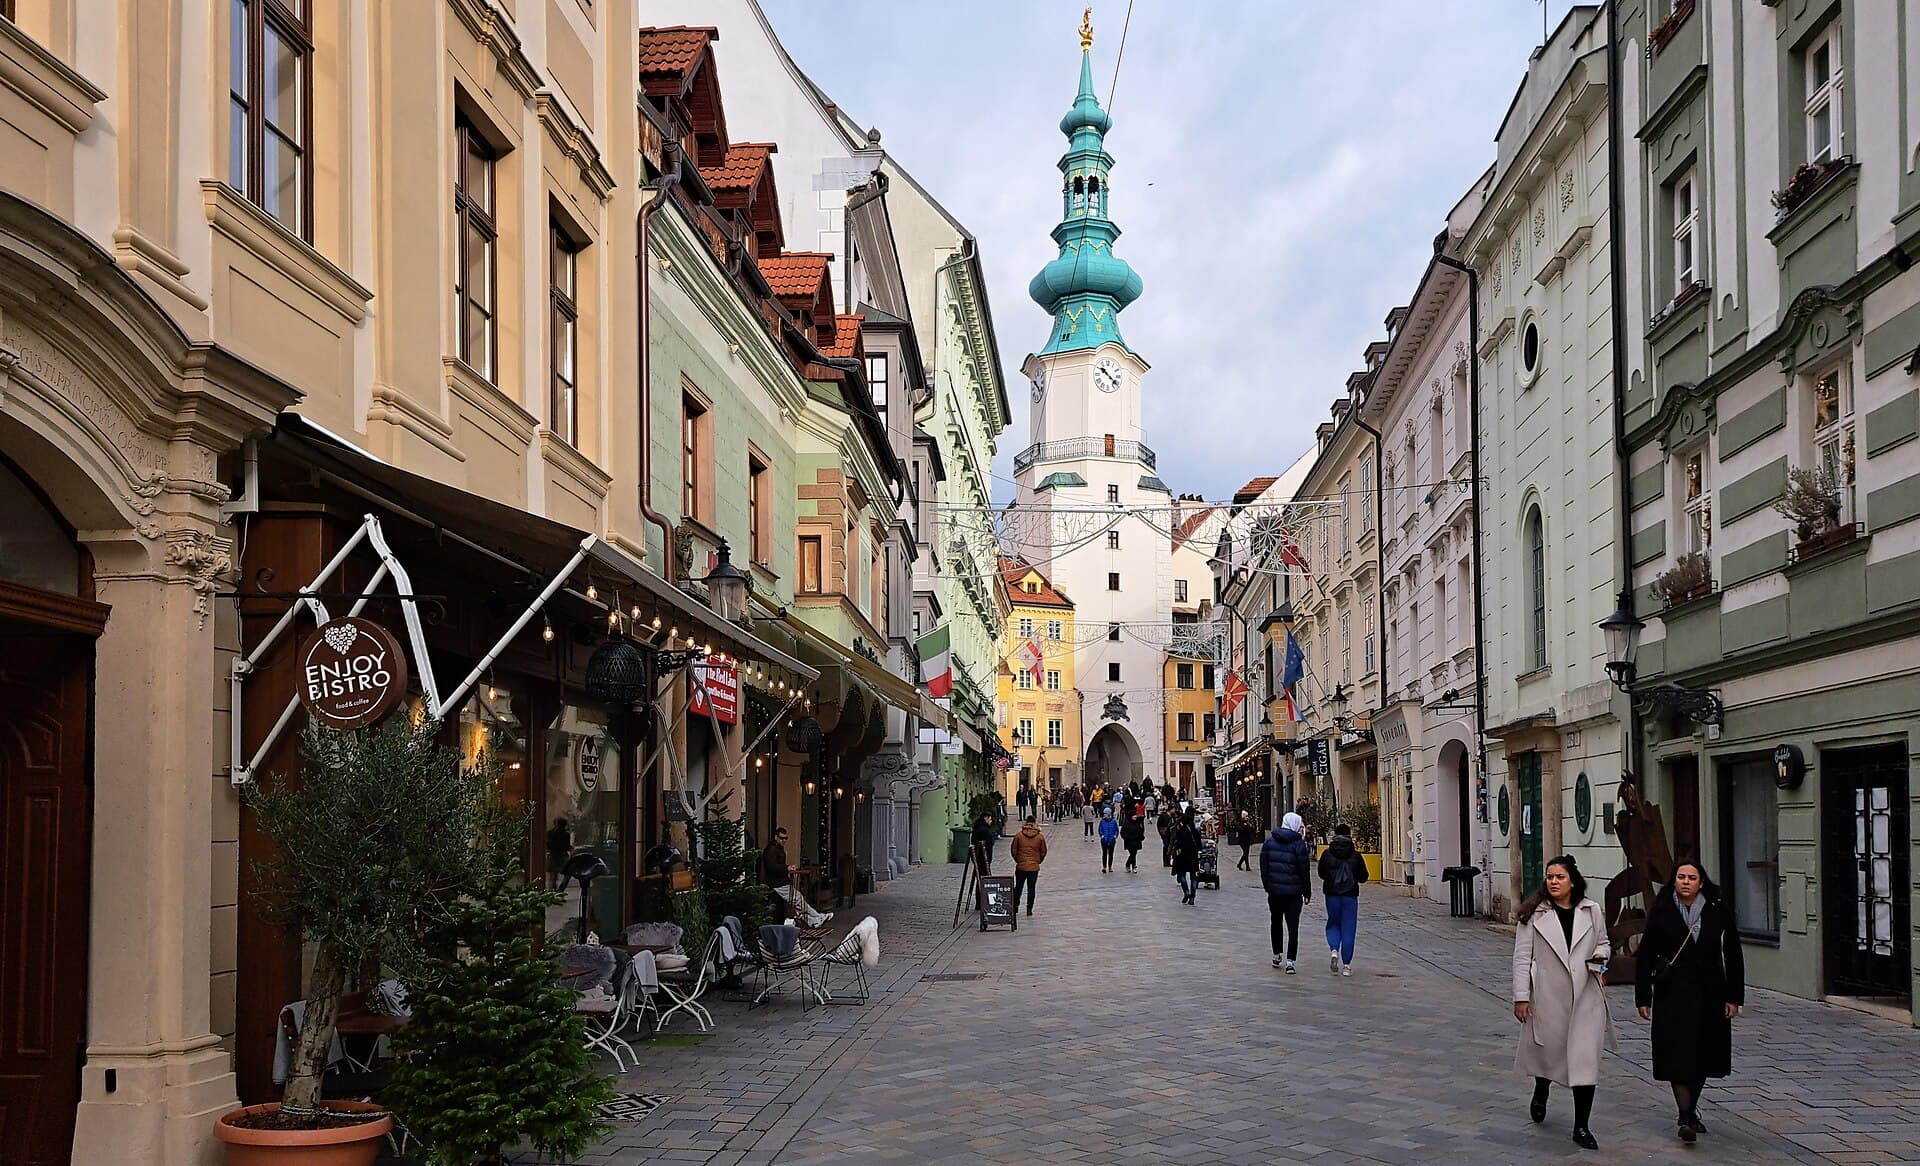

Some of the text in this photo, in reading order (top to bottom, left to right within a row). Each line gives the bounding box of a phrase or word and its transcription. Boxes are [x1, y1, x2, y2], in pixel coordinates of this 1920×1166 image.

[306, 651, 386, 684] ENJOY
[308, 670, 390, 701] BISTRO
[335, 700, 348, 709] food
[1317, 740, 1328, 775] CIGÁR
